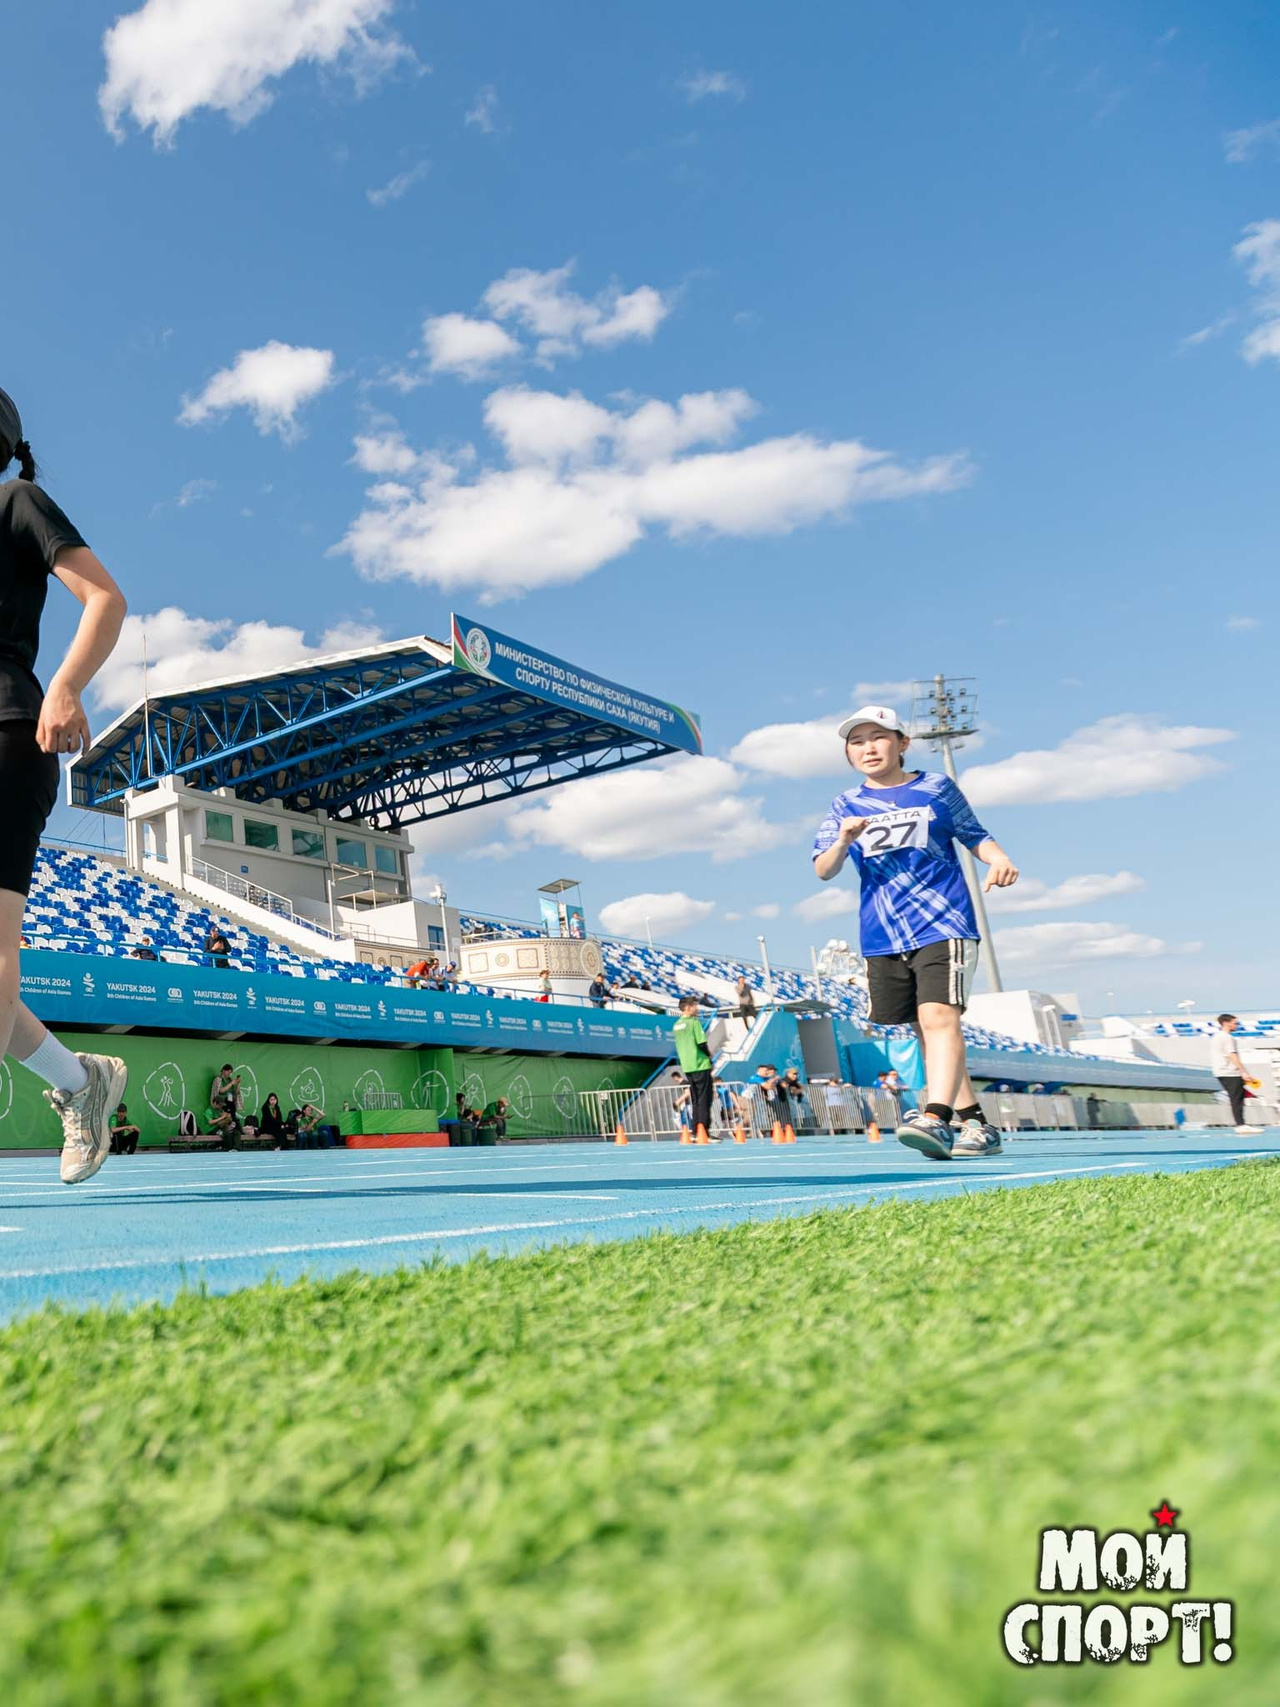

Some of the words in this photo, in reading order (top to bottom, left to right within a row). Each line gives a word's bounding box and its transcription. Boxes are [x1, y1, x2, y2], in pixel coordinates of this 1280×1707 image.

[495, 642, 565, 681] МИНИСТЕРСТВО
[566, 671, 578, 687] ПО
[580, 678, 632, 706] ФИЗИЧЕСКОЙ
[632, 699, 668, 722] КУЛЬТУРЕ
[669, 712, 675, 724] И
[516, 667, 550, 691] СПОРТУ
[552, 681, 605, 711] РЕСПУБЛИКИ
[606, 702, 627, 720] САХА
[628, 709, 660, 734] (ЯКУТИЯ)
[866, 822, 917, 852] 27
[52, 978, 71, 988] 2024
[106, 982, 138, 993] YAKUTSK
[139, 985, 156, 994] 2024
